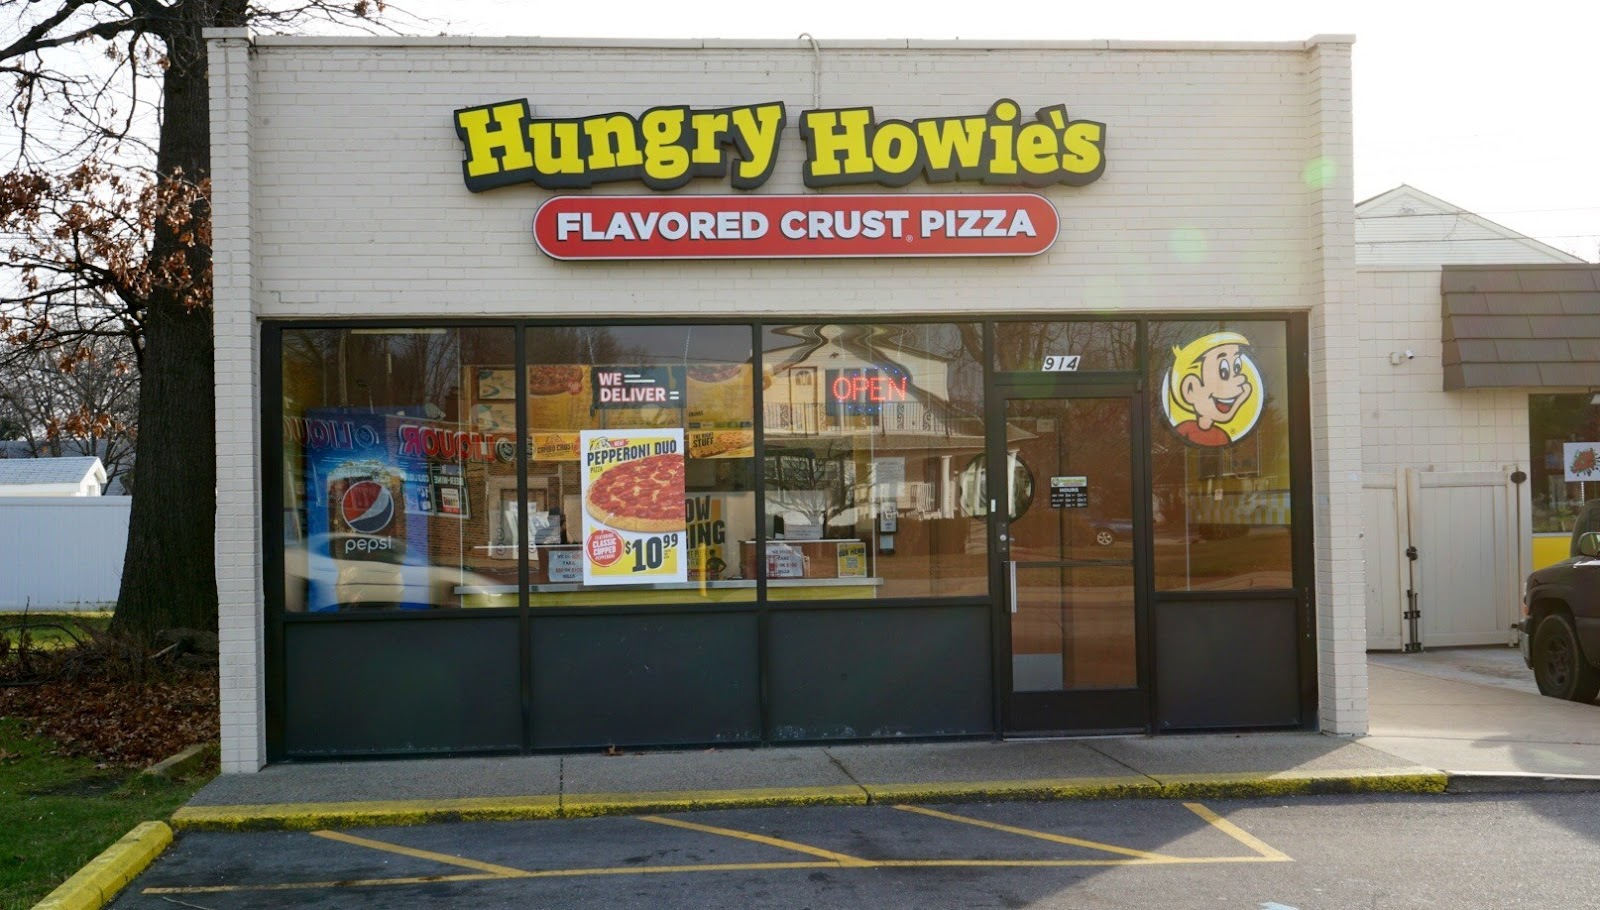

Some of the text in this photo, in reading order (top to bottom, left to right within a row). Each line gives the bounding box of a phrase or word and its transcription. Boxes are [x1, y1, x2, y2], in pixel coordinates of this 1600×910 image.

[456, 101, 1102, 181] Hungry Howie's
[556, 208, 1038, 241] FLAVORED CRUST PIZZA
[1044, 356, 1078, 370] 914
[598, 372, 622, 386] WE
[832, 376, 906, 401] OPEN
[600, 387, 666, 402] DELIVER
[587, 439, 677, 467] PEPPERONI DUO
[685, 495, 711, 522] OW
[345, 536, 391, 554] pepsi
[592, 538, 617, 548] CLASSIC
[686, 520, 726, 549] ING
